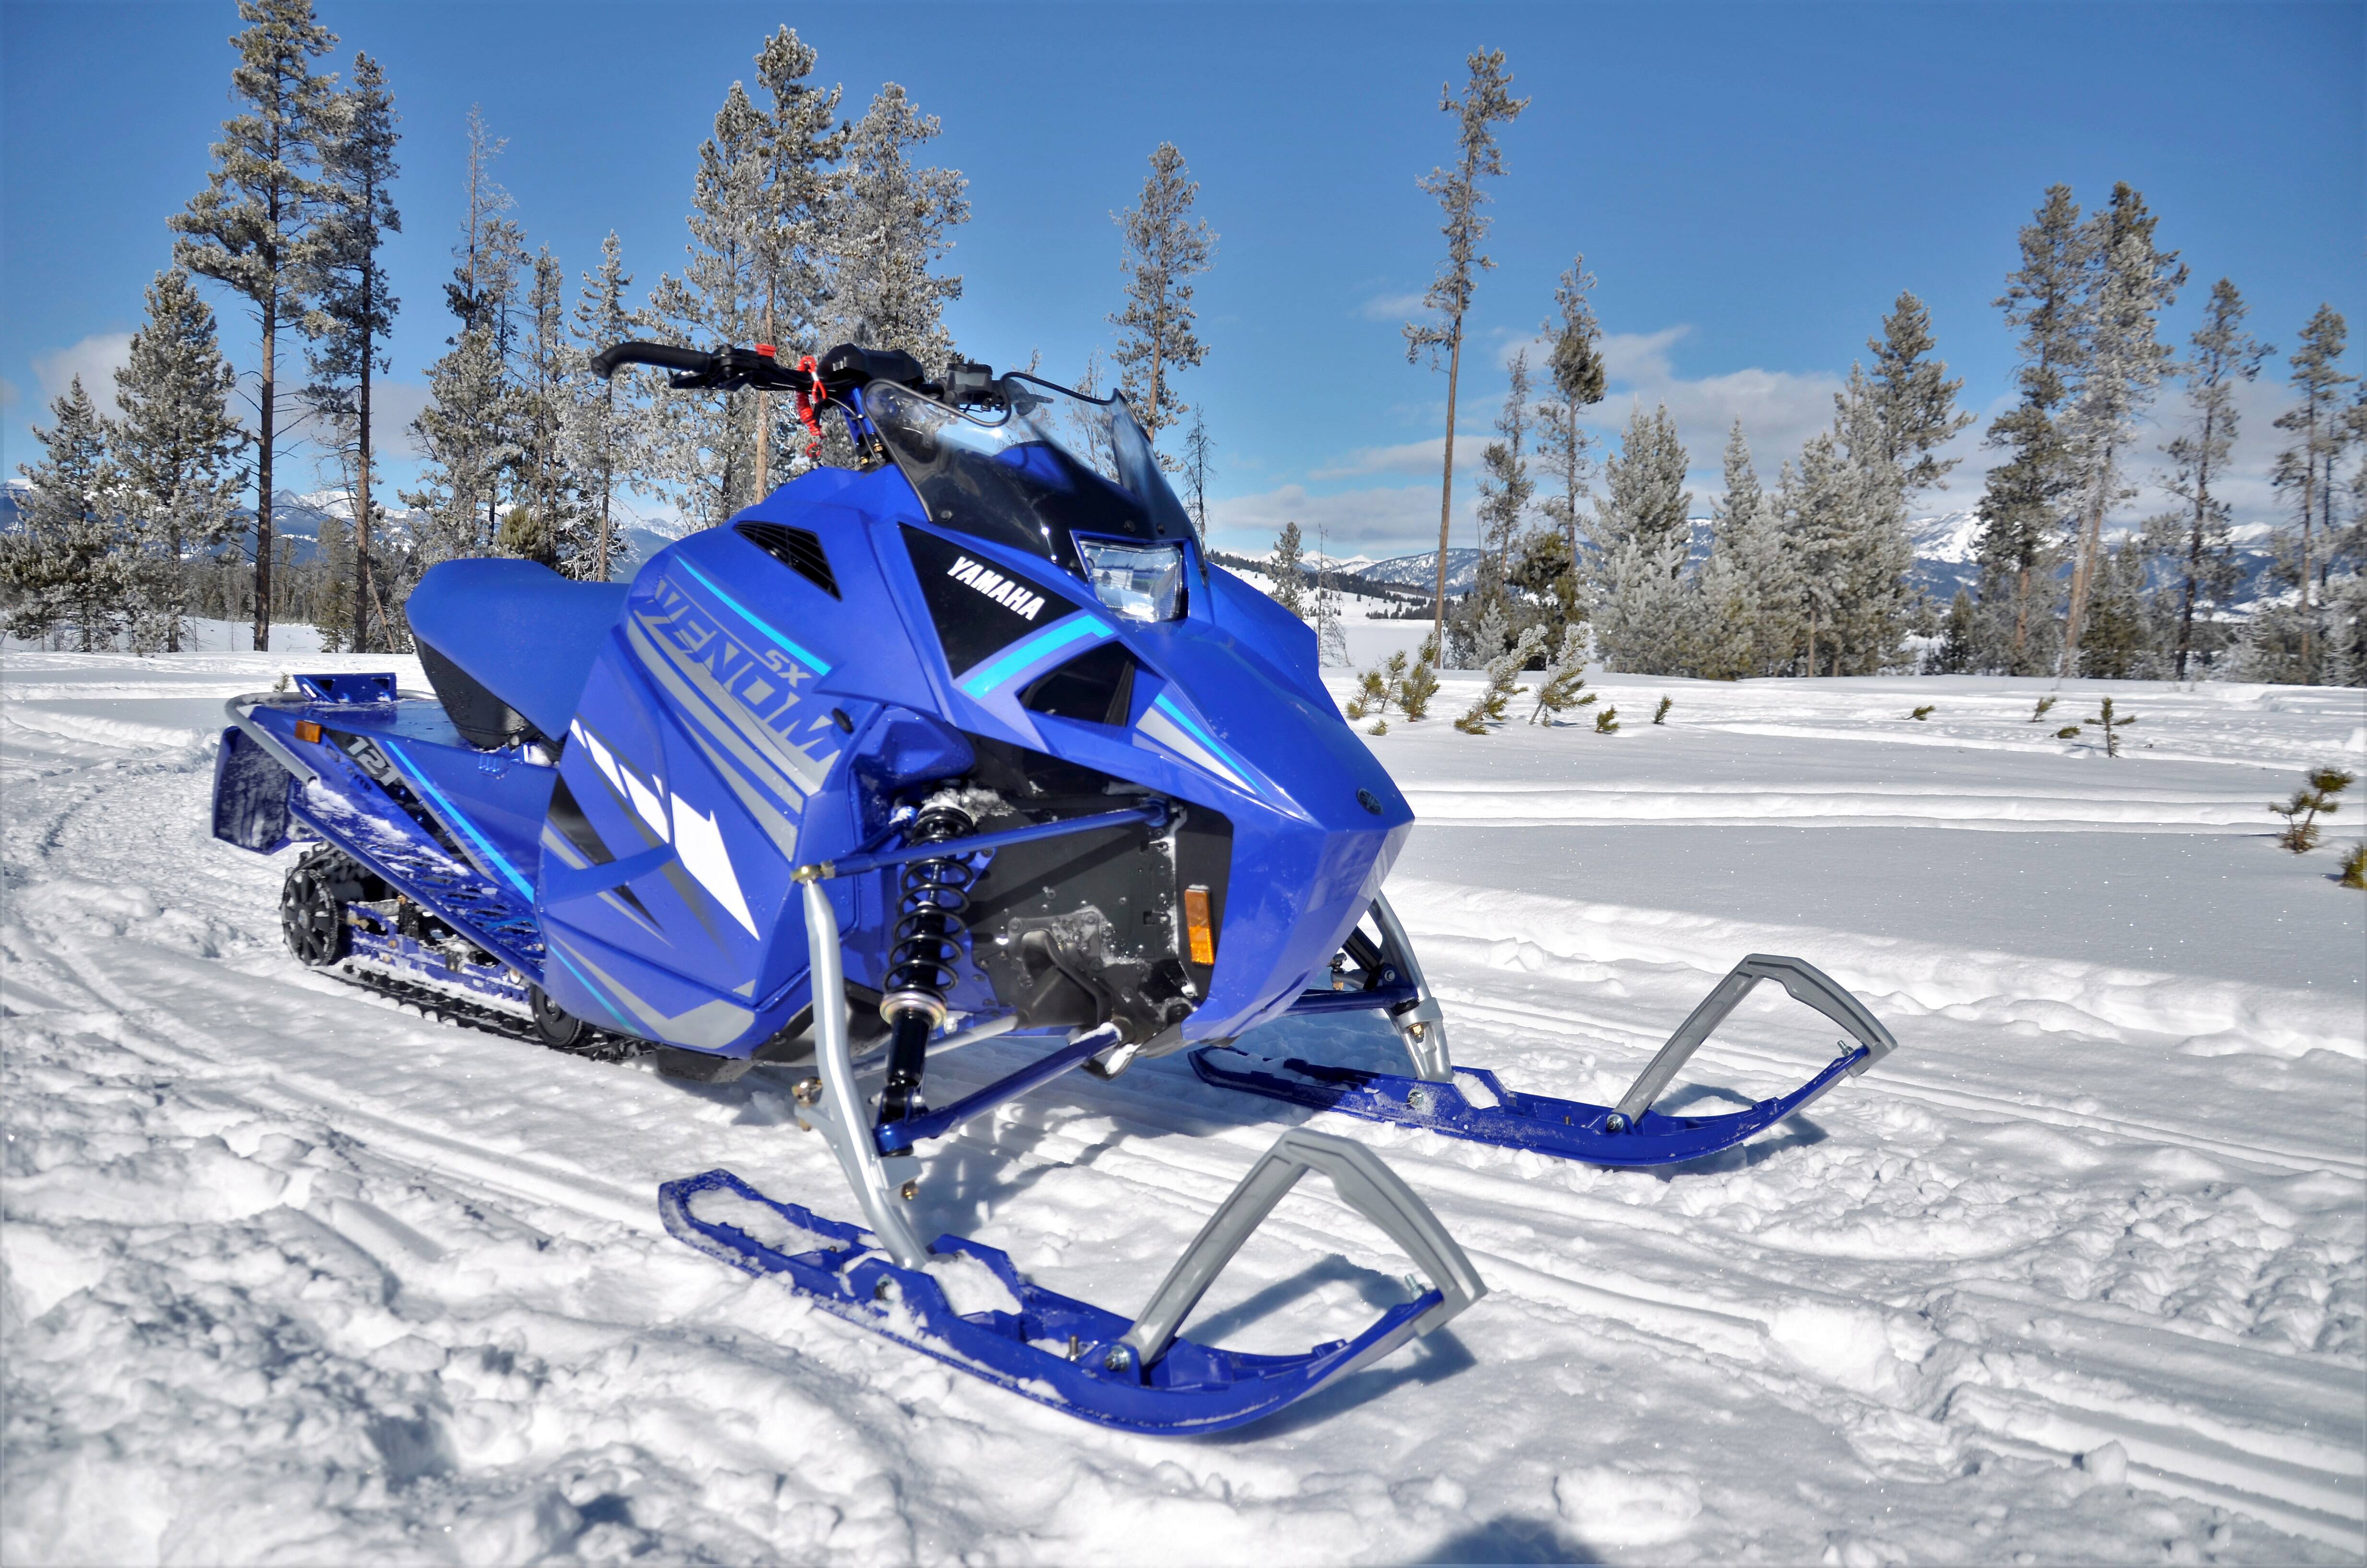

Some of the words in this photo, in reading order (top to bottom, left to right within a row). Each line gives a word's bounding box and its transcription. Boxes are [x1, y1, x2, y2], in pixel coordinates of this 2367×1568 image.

[947, 556, 1046, 621] YAMAHA
[635, 576, 842, 764] VENOM
[765, 649, 812, 688] SX
[347, 736, 400, 786] 121
